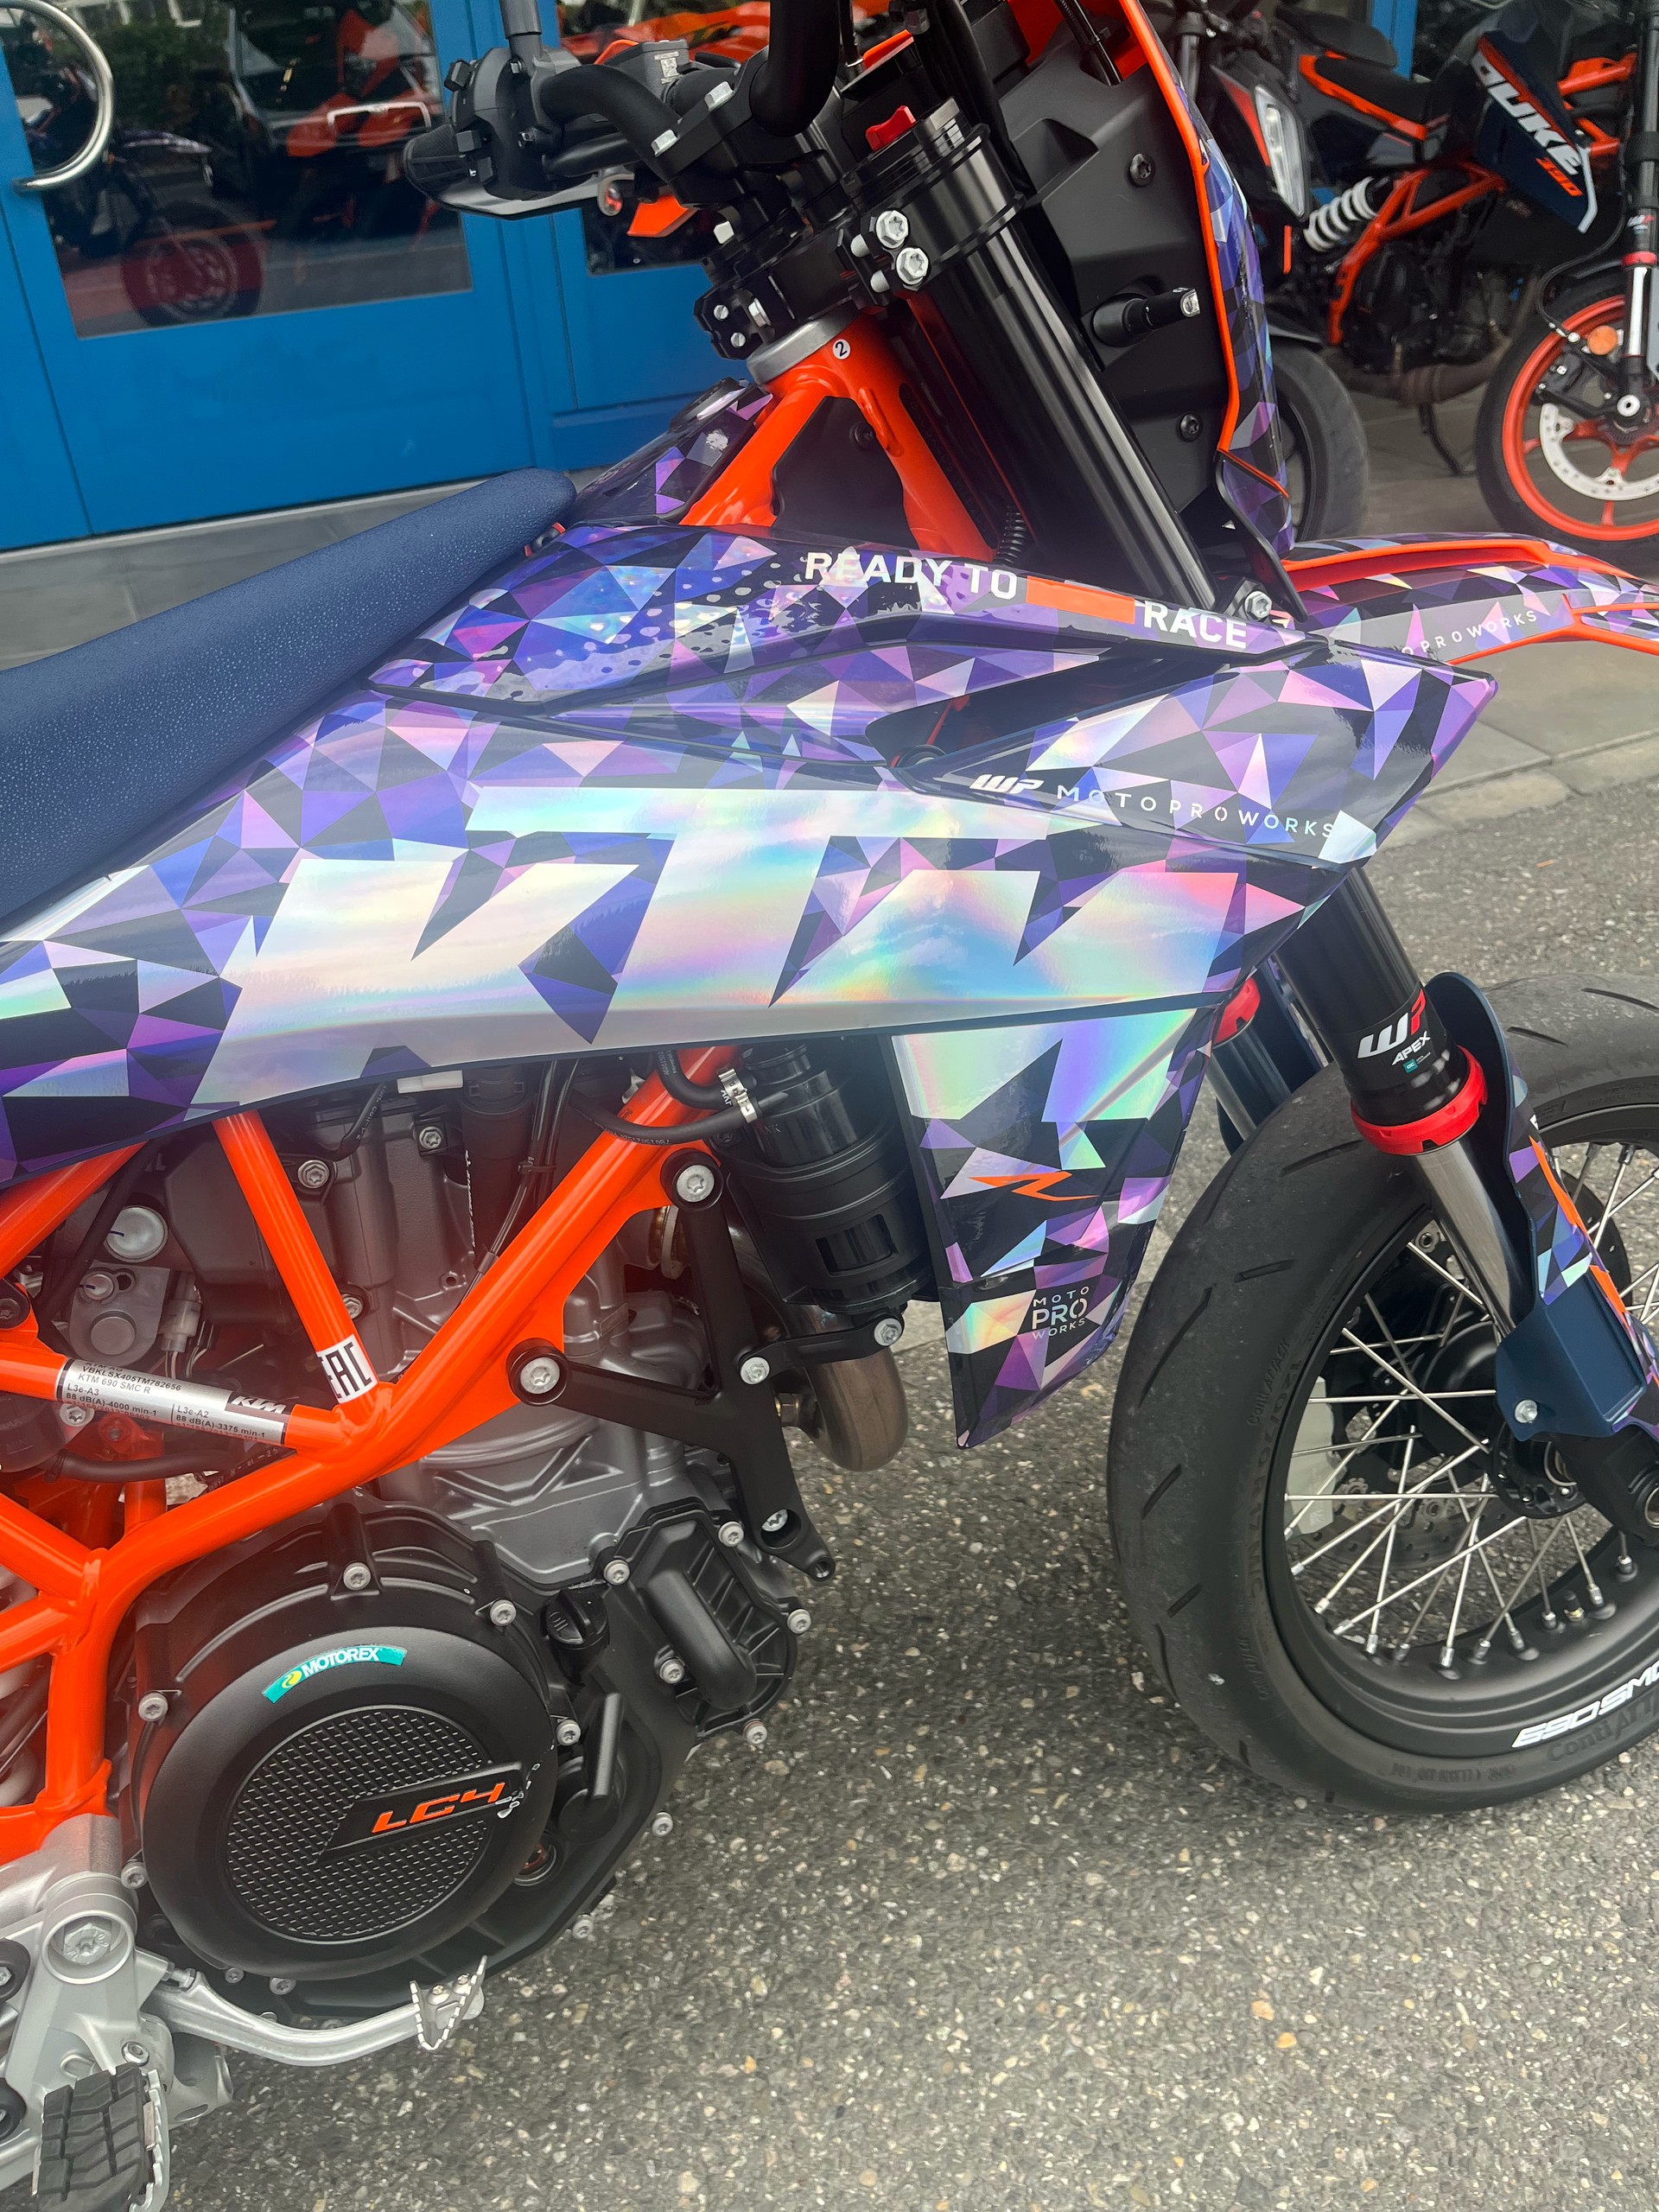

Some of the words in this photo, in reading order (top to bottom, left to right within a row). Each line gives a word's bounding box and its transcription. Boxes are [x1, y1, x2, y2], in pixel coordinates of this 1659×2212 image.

[1471, 51, 1582, 175] DUKE
[835, 340, 848, 357] 2
[804, 551, 953, 587] READY
[964, 563, 1019, 601] TO
[1143, 600, 1248, 650] RACE
[969, 773, 1045, 794] WP
[1057, 784, 1334, 840] MOTOPROWORKS
[1357, 988, 1427, 1059] WP
[1391, 1030, 1431, 1066] APEX
[1033, 1286, 1090, 1307] MOTO
[1032, 1298, 1088, 1330] PRO
[1032, 1318, 1085, 1340] WORKS
[67, 1383, 99, 1396] L3e-A3
[78, 1372, 99, 1384] KTM
[101, 1377, 118, 1388] 690
[119, 1380, 142, 1392] SMC
[143, 1385, 151, 1395] R
[82, 1365, 182, 1391] VBKLSX405TM782656
[66, 1392, 77, 1401] 88
[79, 1395, 130, 1411] dB(A)-4000
[132, 1407, 157, 1416] min-1
[177, 1404, 209, 1418] L3e-A2
[230, 1395, 287, 1414] KTM
[175, 1414, 187, 1422] 88
[188, 1417, 238, 1433] dB(A)-3375
[240, 1428, 265, 1438] min-1
[302, 1647, 380, 1679] MOTOREX
[371, 1781, 505, 1834] LC4
